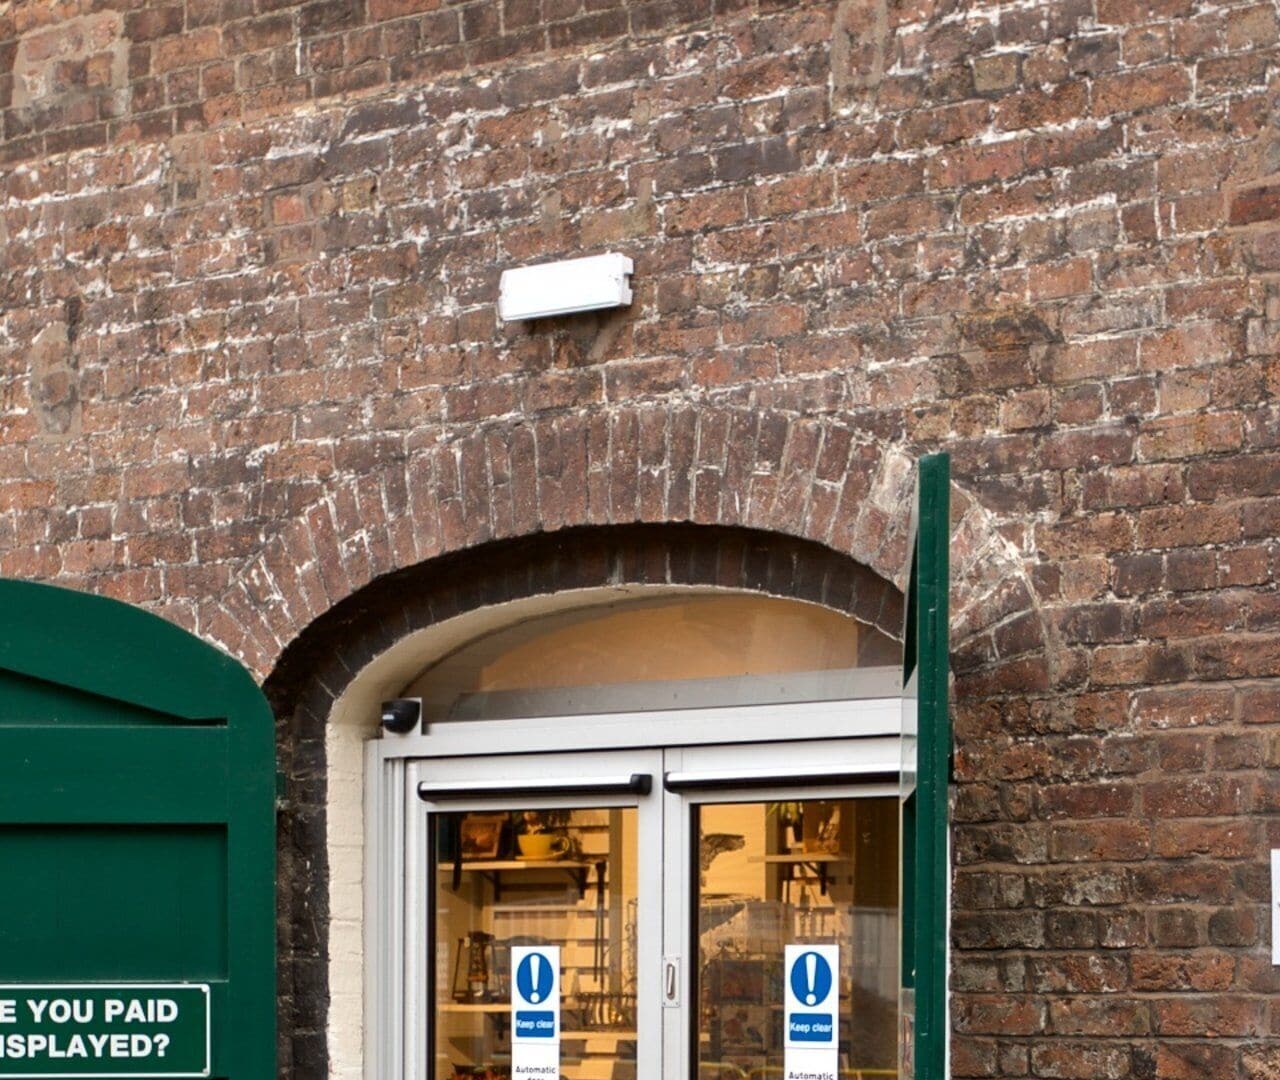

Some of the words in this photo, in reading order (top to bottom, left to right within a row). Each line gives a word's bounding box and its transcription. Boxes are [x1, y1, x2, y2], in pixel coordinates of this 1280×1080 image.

[28, 999, 93, 1023] YOU
[105, 999, 179, 1023] PAID
[516, 1019, 535, 1030] Keep
[536, 1019, 554, 1029] clear
[790, 1022, 810, 1034] Keep
[812, 1022, 832, 1033] clear
[515, 1065, 556, 1074] Automatic
[788, 1071, 834, 1080] Automatic
